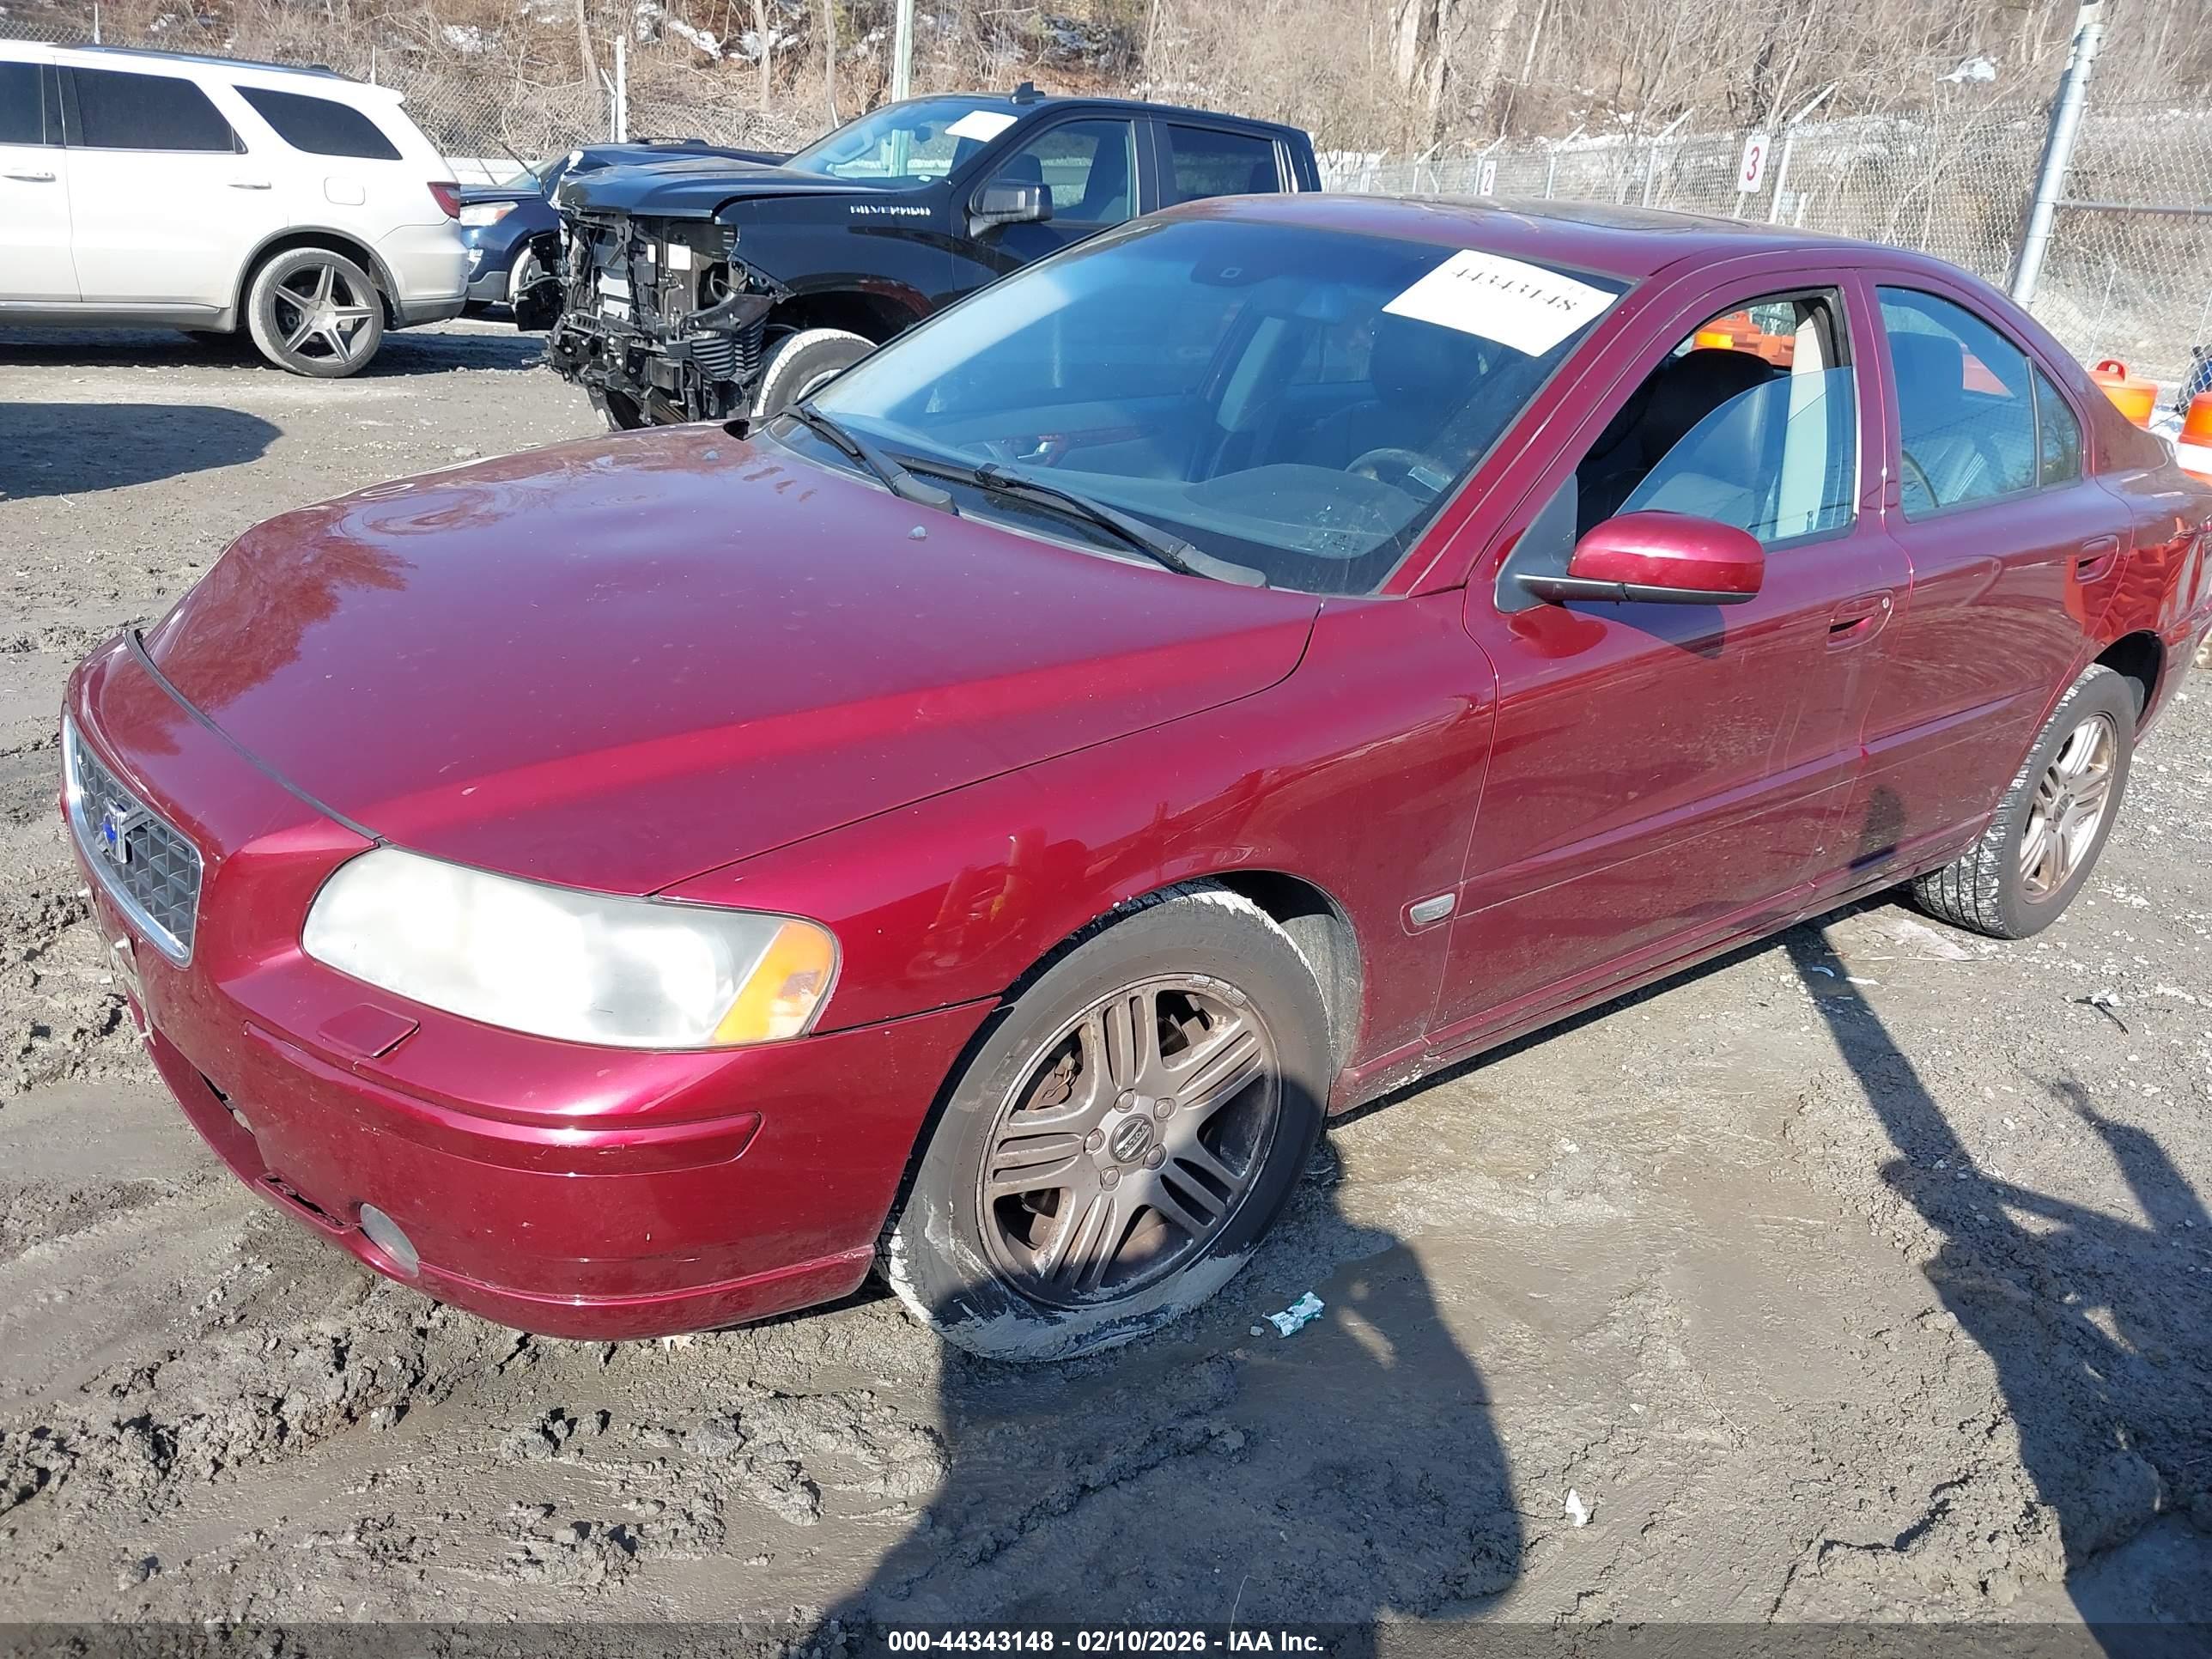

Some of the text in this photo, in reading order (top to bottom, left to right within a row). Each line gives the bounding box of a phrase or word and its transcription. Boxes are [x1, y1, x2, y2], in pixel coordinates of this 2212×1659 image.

[1484, 168, 1492, 192] 2
[1747, 146, 1760, 182] 3
[1451, 267, 1578, 312] 44343148
[1116, 1124, 1150, 1158] VOLVO
